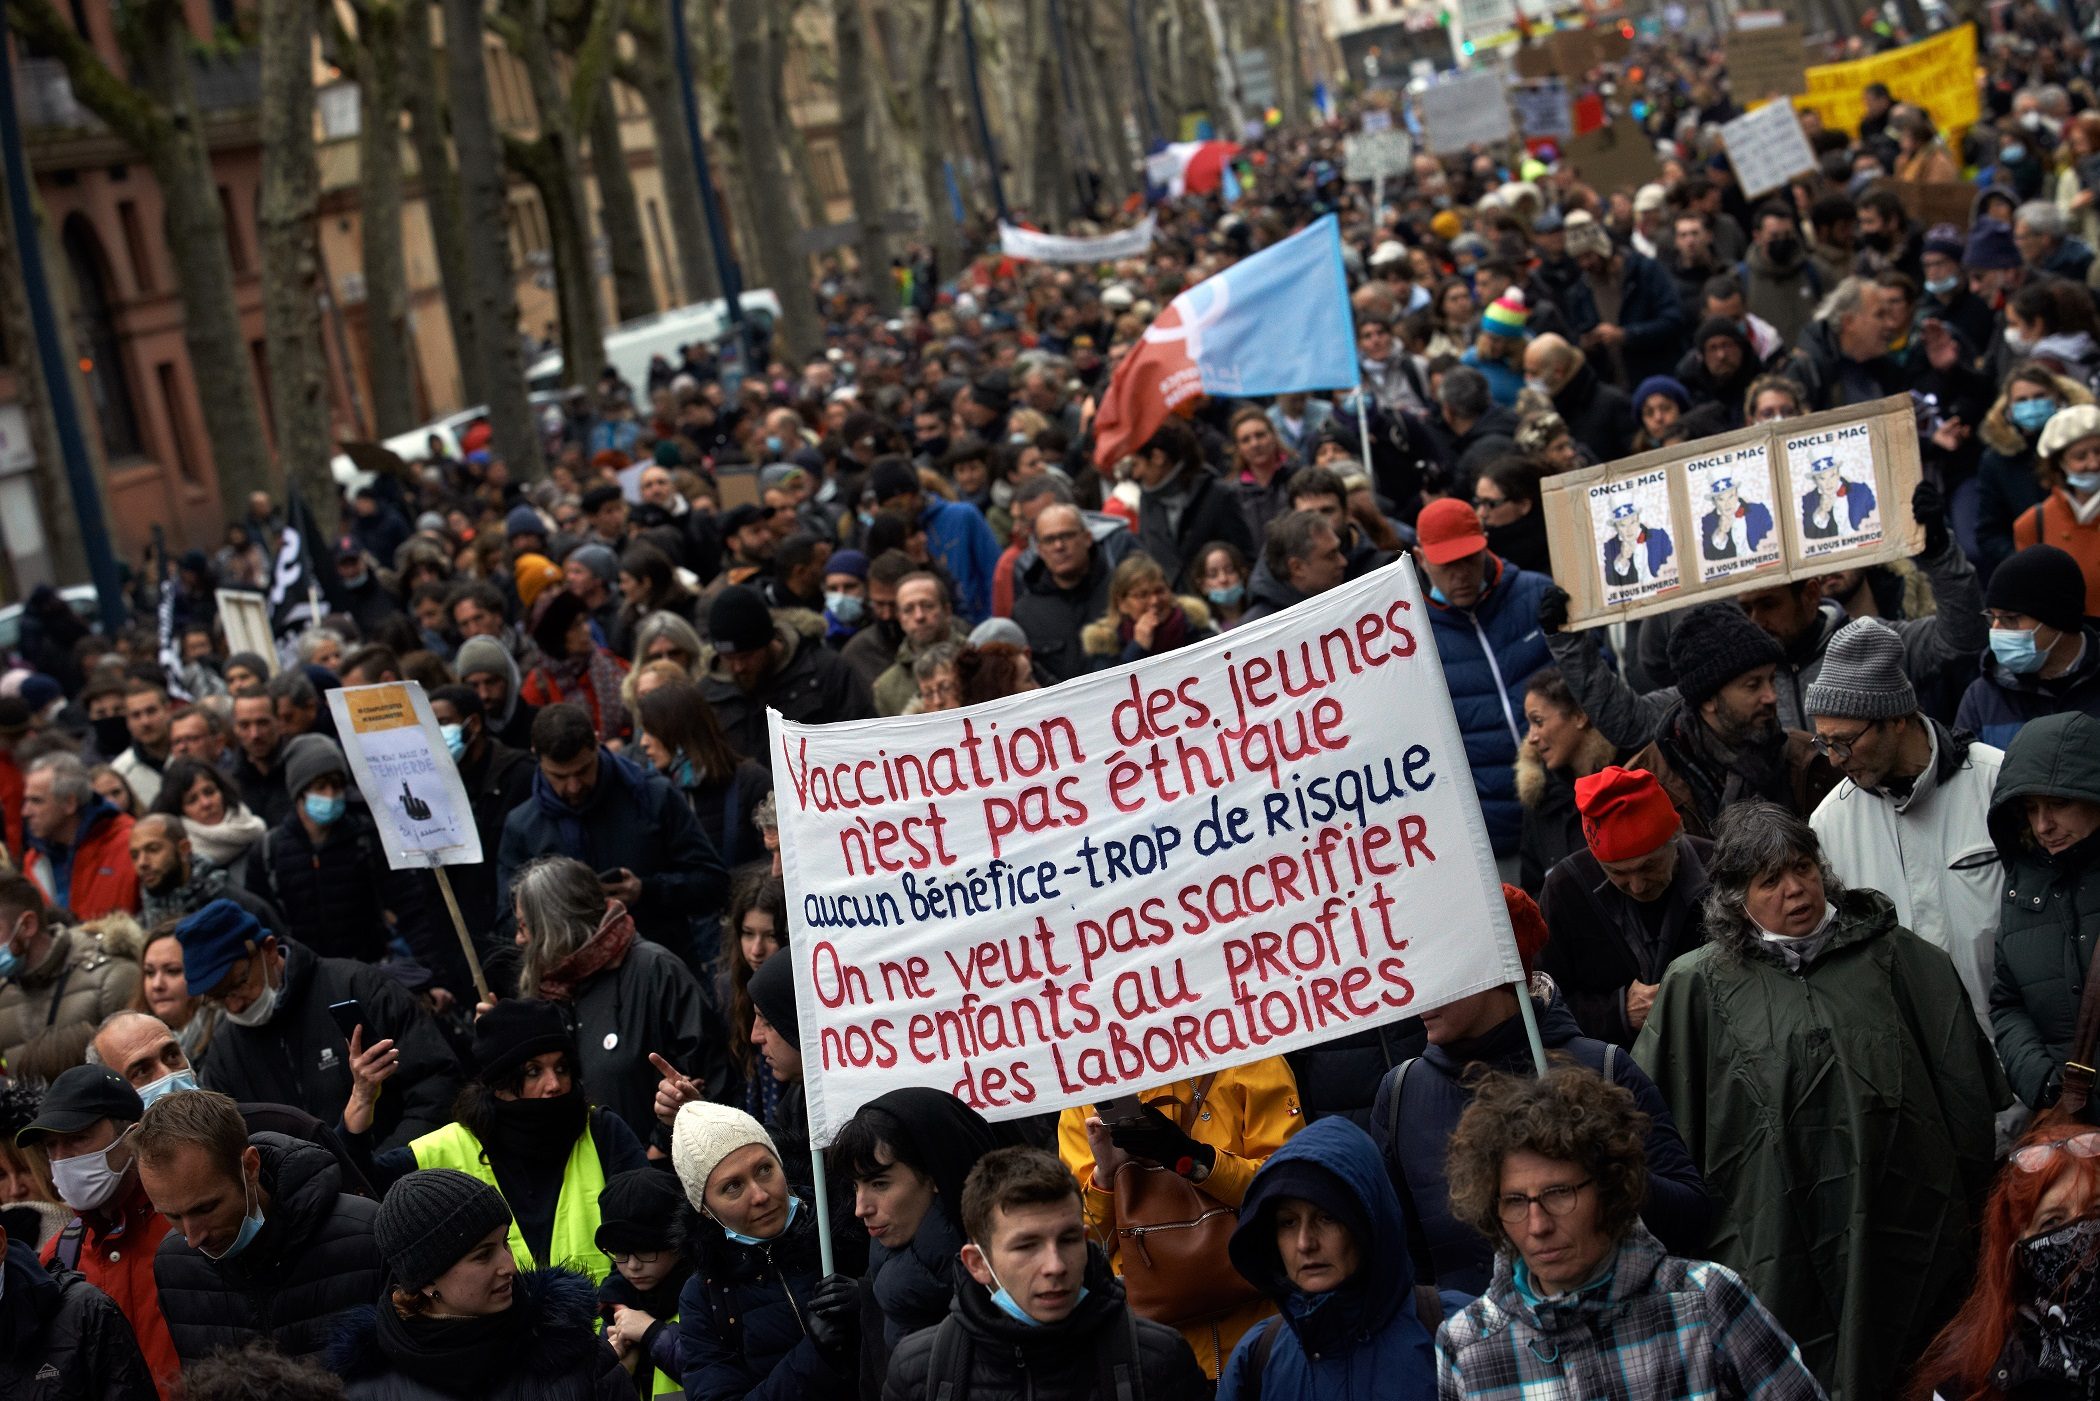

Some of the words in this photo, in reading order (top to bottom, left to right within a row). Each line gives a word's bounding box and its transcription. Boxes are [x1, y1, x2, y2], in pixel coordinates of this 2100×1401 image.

[1787, 433, 1834, 450] ONCLE
[1838, 426, 1867, 440] MAC
[1688, 454, 1732, 472] ONCLE
[1737, 446, 1765, 460] MAC
[1590, 480, 1633, 497] ONCLE
[1638, 471, 1665, 486] MAC
[1805, 545, 1815, 554] JE
[1817, 541, 1840, 552] VOUS
[1842, 531, 1882, 546] EMMERDE
[1705, 567, 1715, 576] JE
[1716, 562, 1738, 572] VOUS
[1740, 552, 1779, 567] EMMERDE
[1608, 592, 1618, 601] JE
[1619, 587, 1639, 598] VOUS
[1641, 578, 1679, 593] EMMERDE
[783, 717, 1086, 812] Vaccination
[1111, 674, 1210, 747] des
[1223, 600, 1417, 740] jeunes
[840, 803, 957, 876] n'est
[983, 776, 1088, 858] pas
[1104, 698, 1351, 813] éthique
[804, 892, 905, 928] aucun
[1194, 795, 1254, 856] de
[812, 941, 874, 1008] On
[879, 956, 936, 1001] ne
[944, 916, 1071, 992] veut
[1076, 898, 1174, 982] pas
[821, 1018, 898, 1070] nos
[908, 979, 1101, 1065] enfants
[1112, 958, 1202, 1020] au
[952, 1060, 1037, 1109] des
